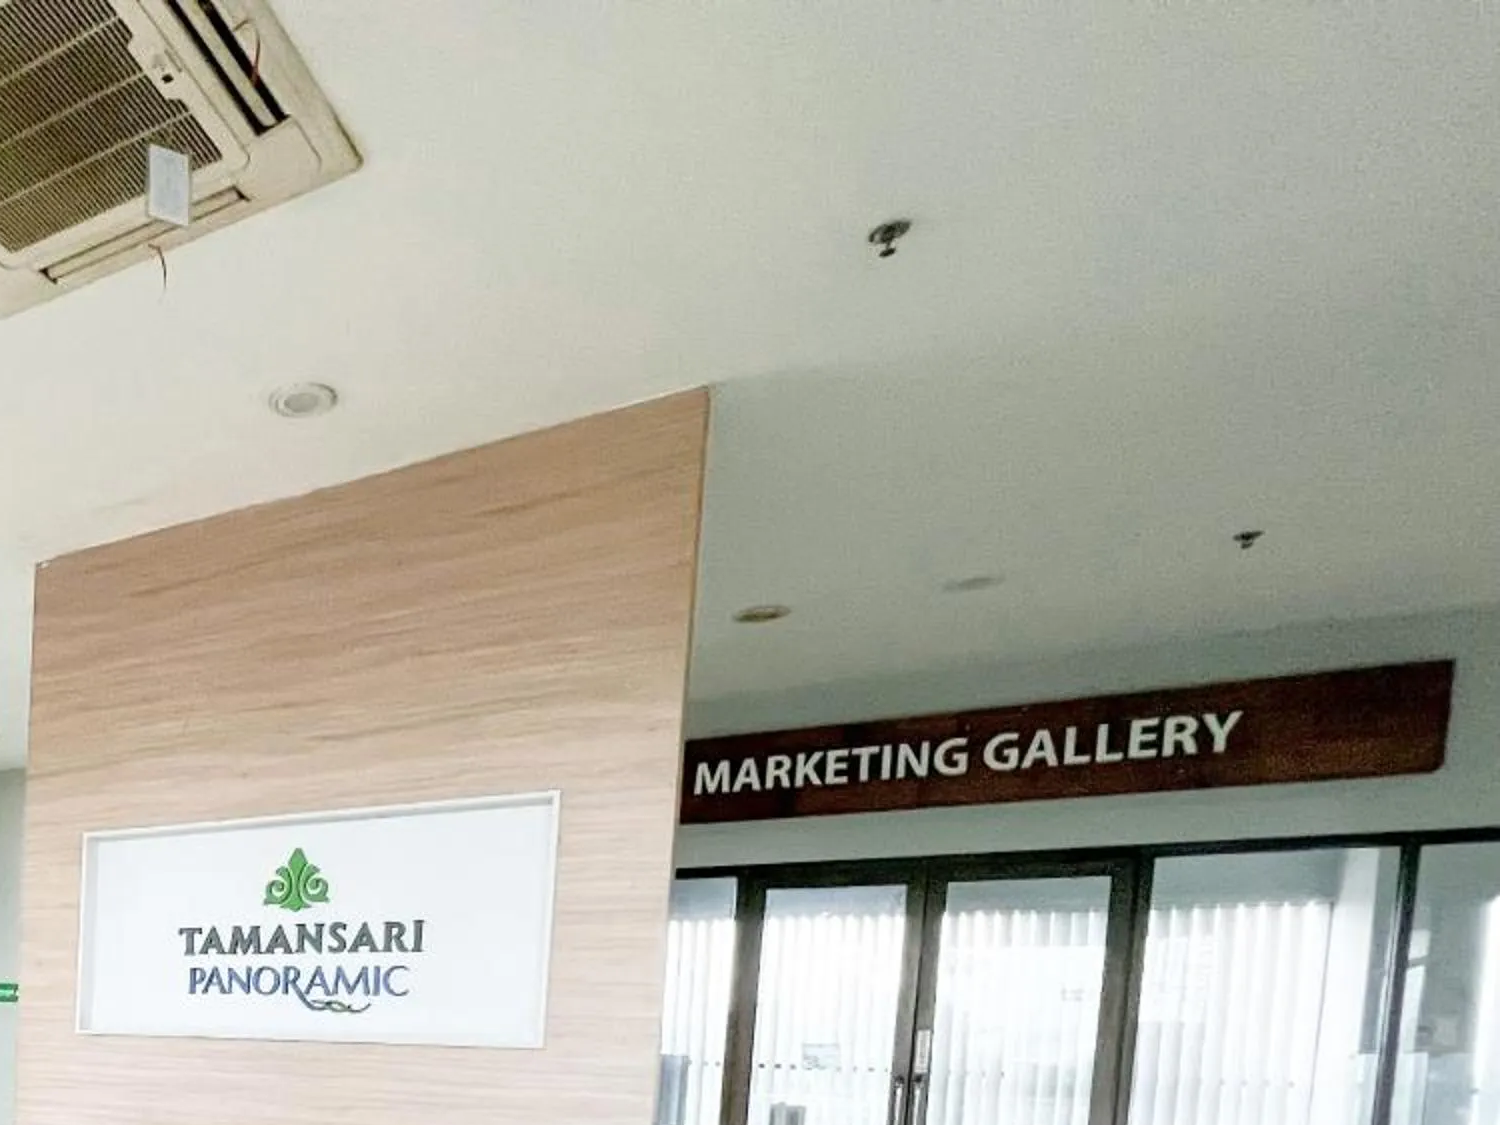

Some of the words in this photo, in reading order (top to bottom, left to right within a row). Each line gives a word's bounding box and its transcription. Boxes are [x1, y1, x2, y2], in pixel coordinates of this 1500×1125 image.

[693, 737, 969, 796] MARKETING
[982, 710, 1243, 771] GALLERY
[178, 919, 426, 956] TAMANSARI
[187, 964, 411, 1012] PANORAMIC
